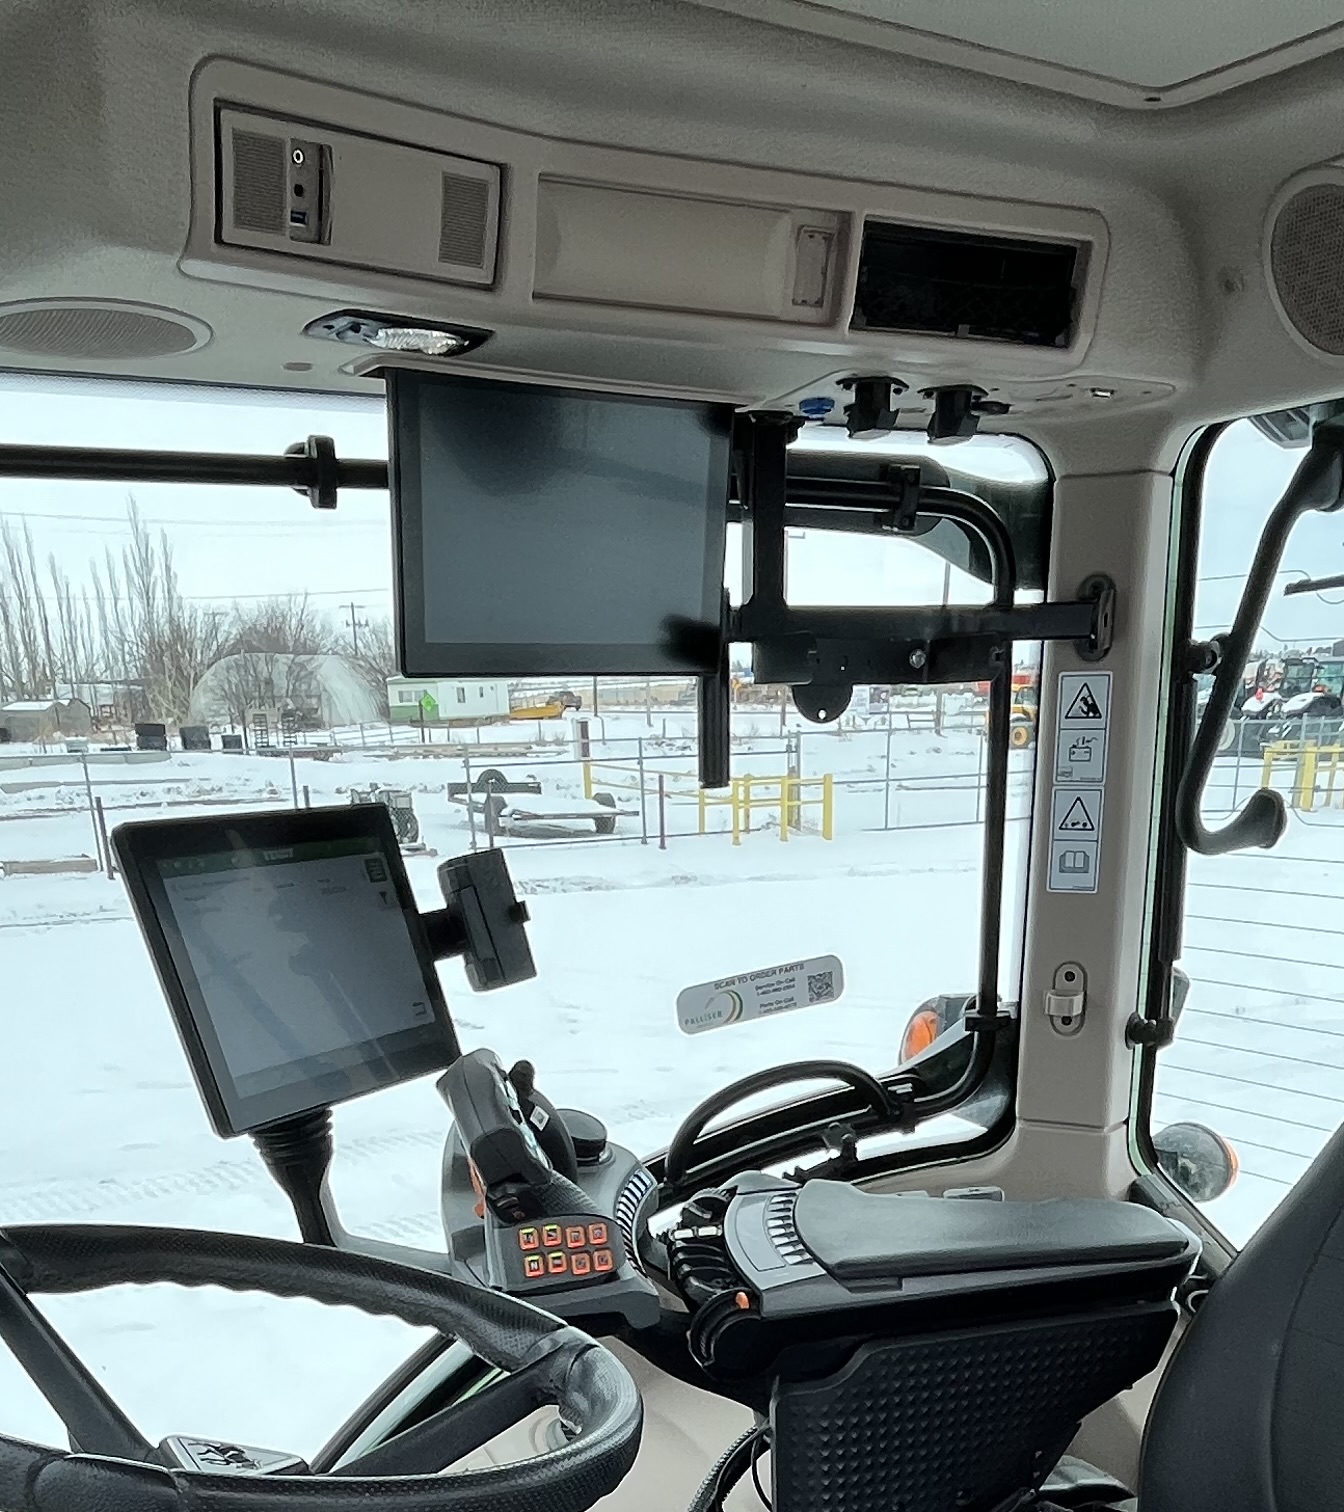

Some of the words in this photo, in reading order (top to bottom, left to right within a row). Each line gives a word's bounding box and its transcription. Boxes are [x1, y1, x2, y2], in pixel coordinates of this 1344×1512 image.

[714, 980, 736, 990] SCAN
[737, 976, 749, 984] TO
[750, 969, 777, 981] ORDER
[779, 963, 805, 975] PARTS
